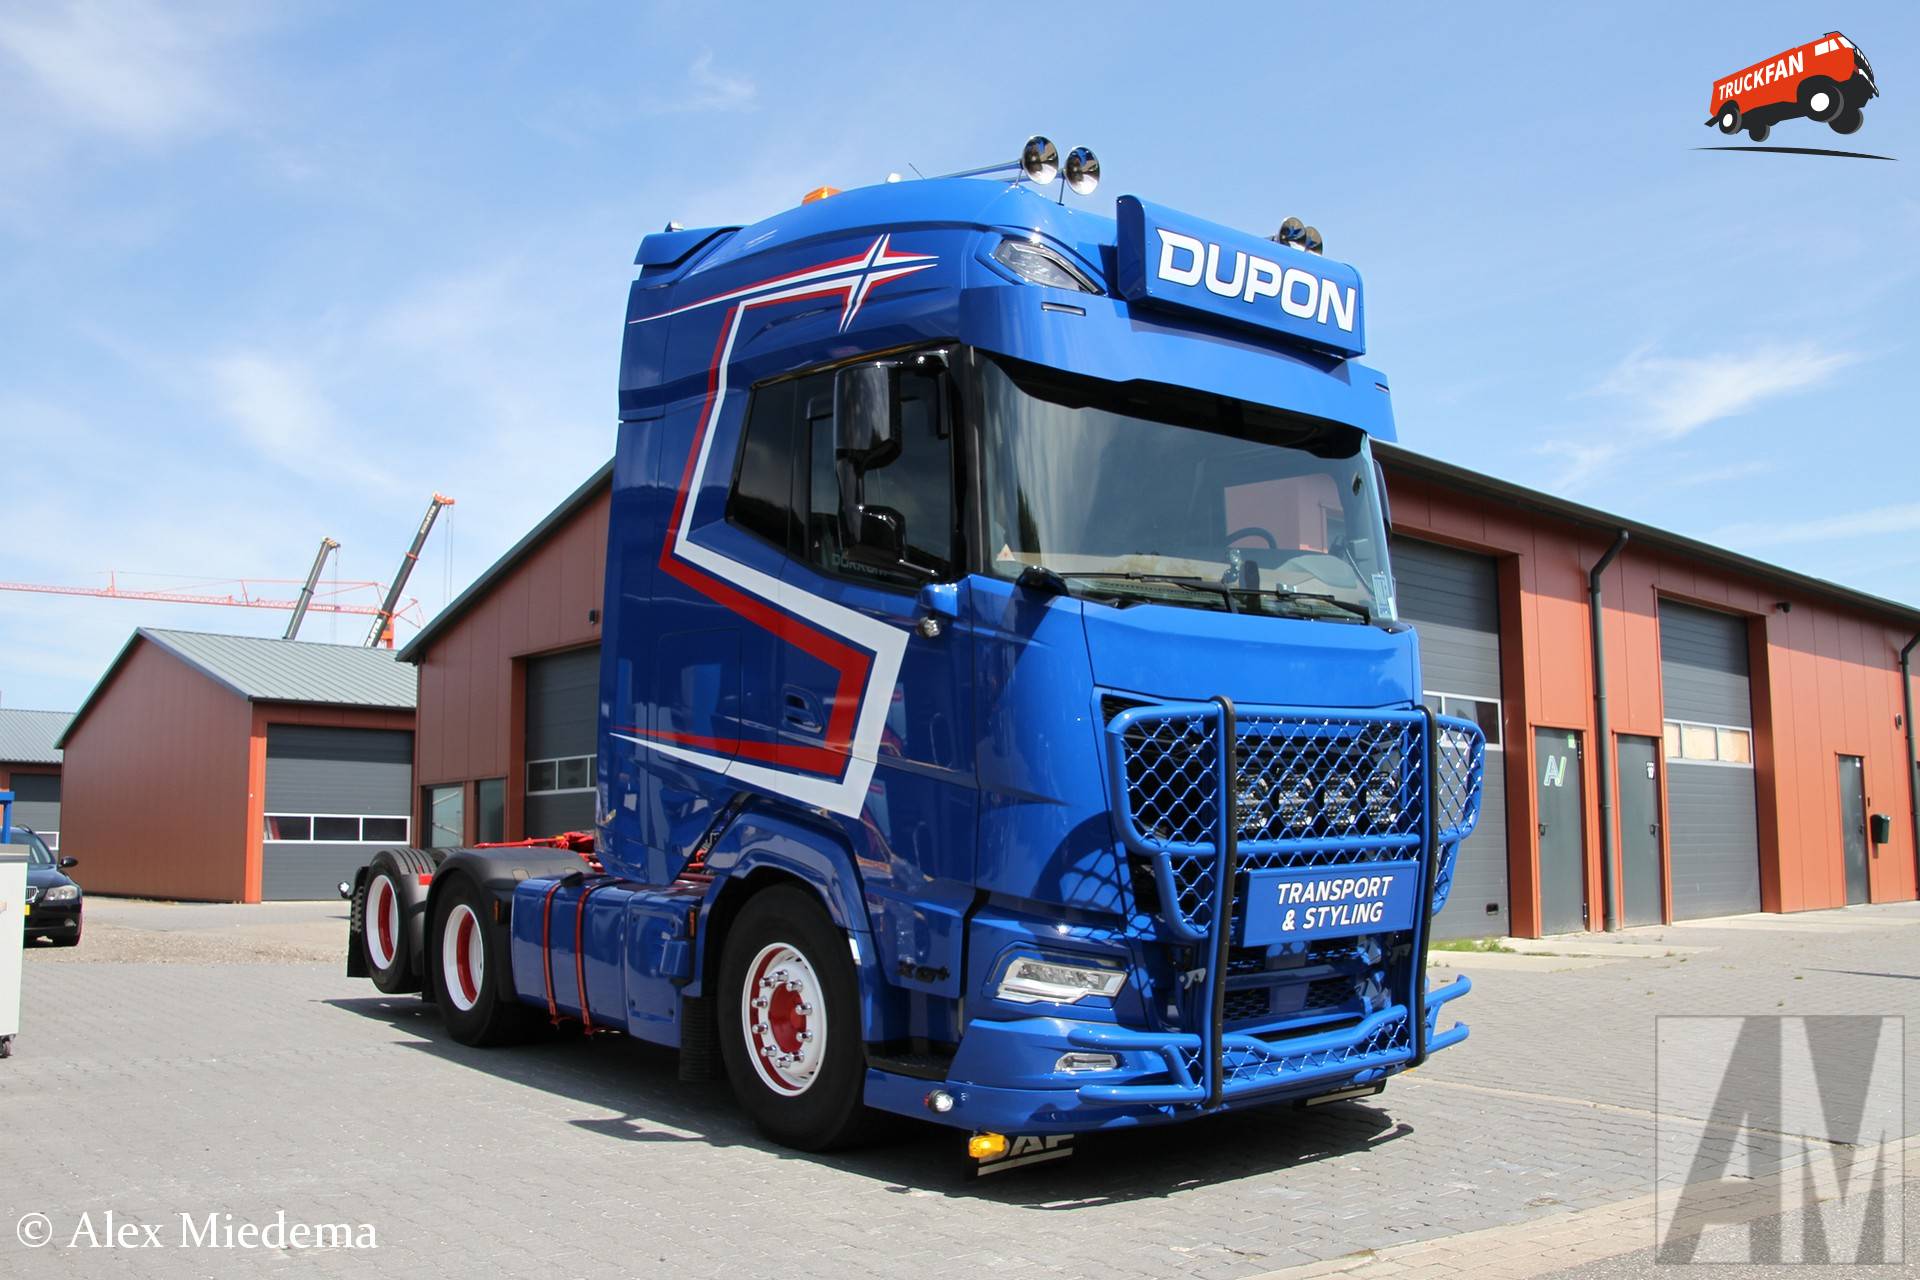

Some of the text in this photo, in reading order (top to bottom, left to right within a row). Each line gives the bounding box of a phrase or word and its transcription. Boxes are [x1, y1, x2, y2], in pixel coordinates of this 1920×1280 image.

[1155, 227, 1356, 333] DUPON
[1277, 876, 1393, 905] TRANSPORT
[1281, 901, 1384, 931] & STYLING
